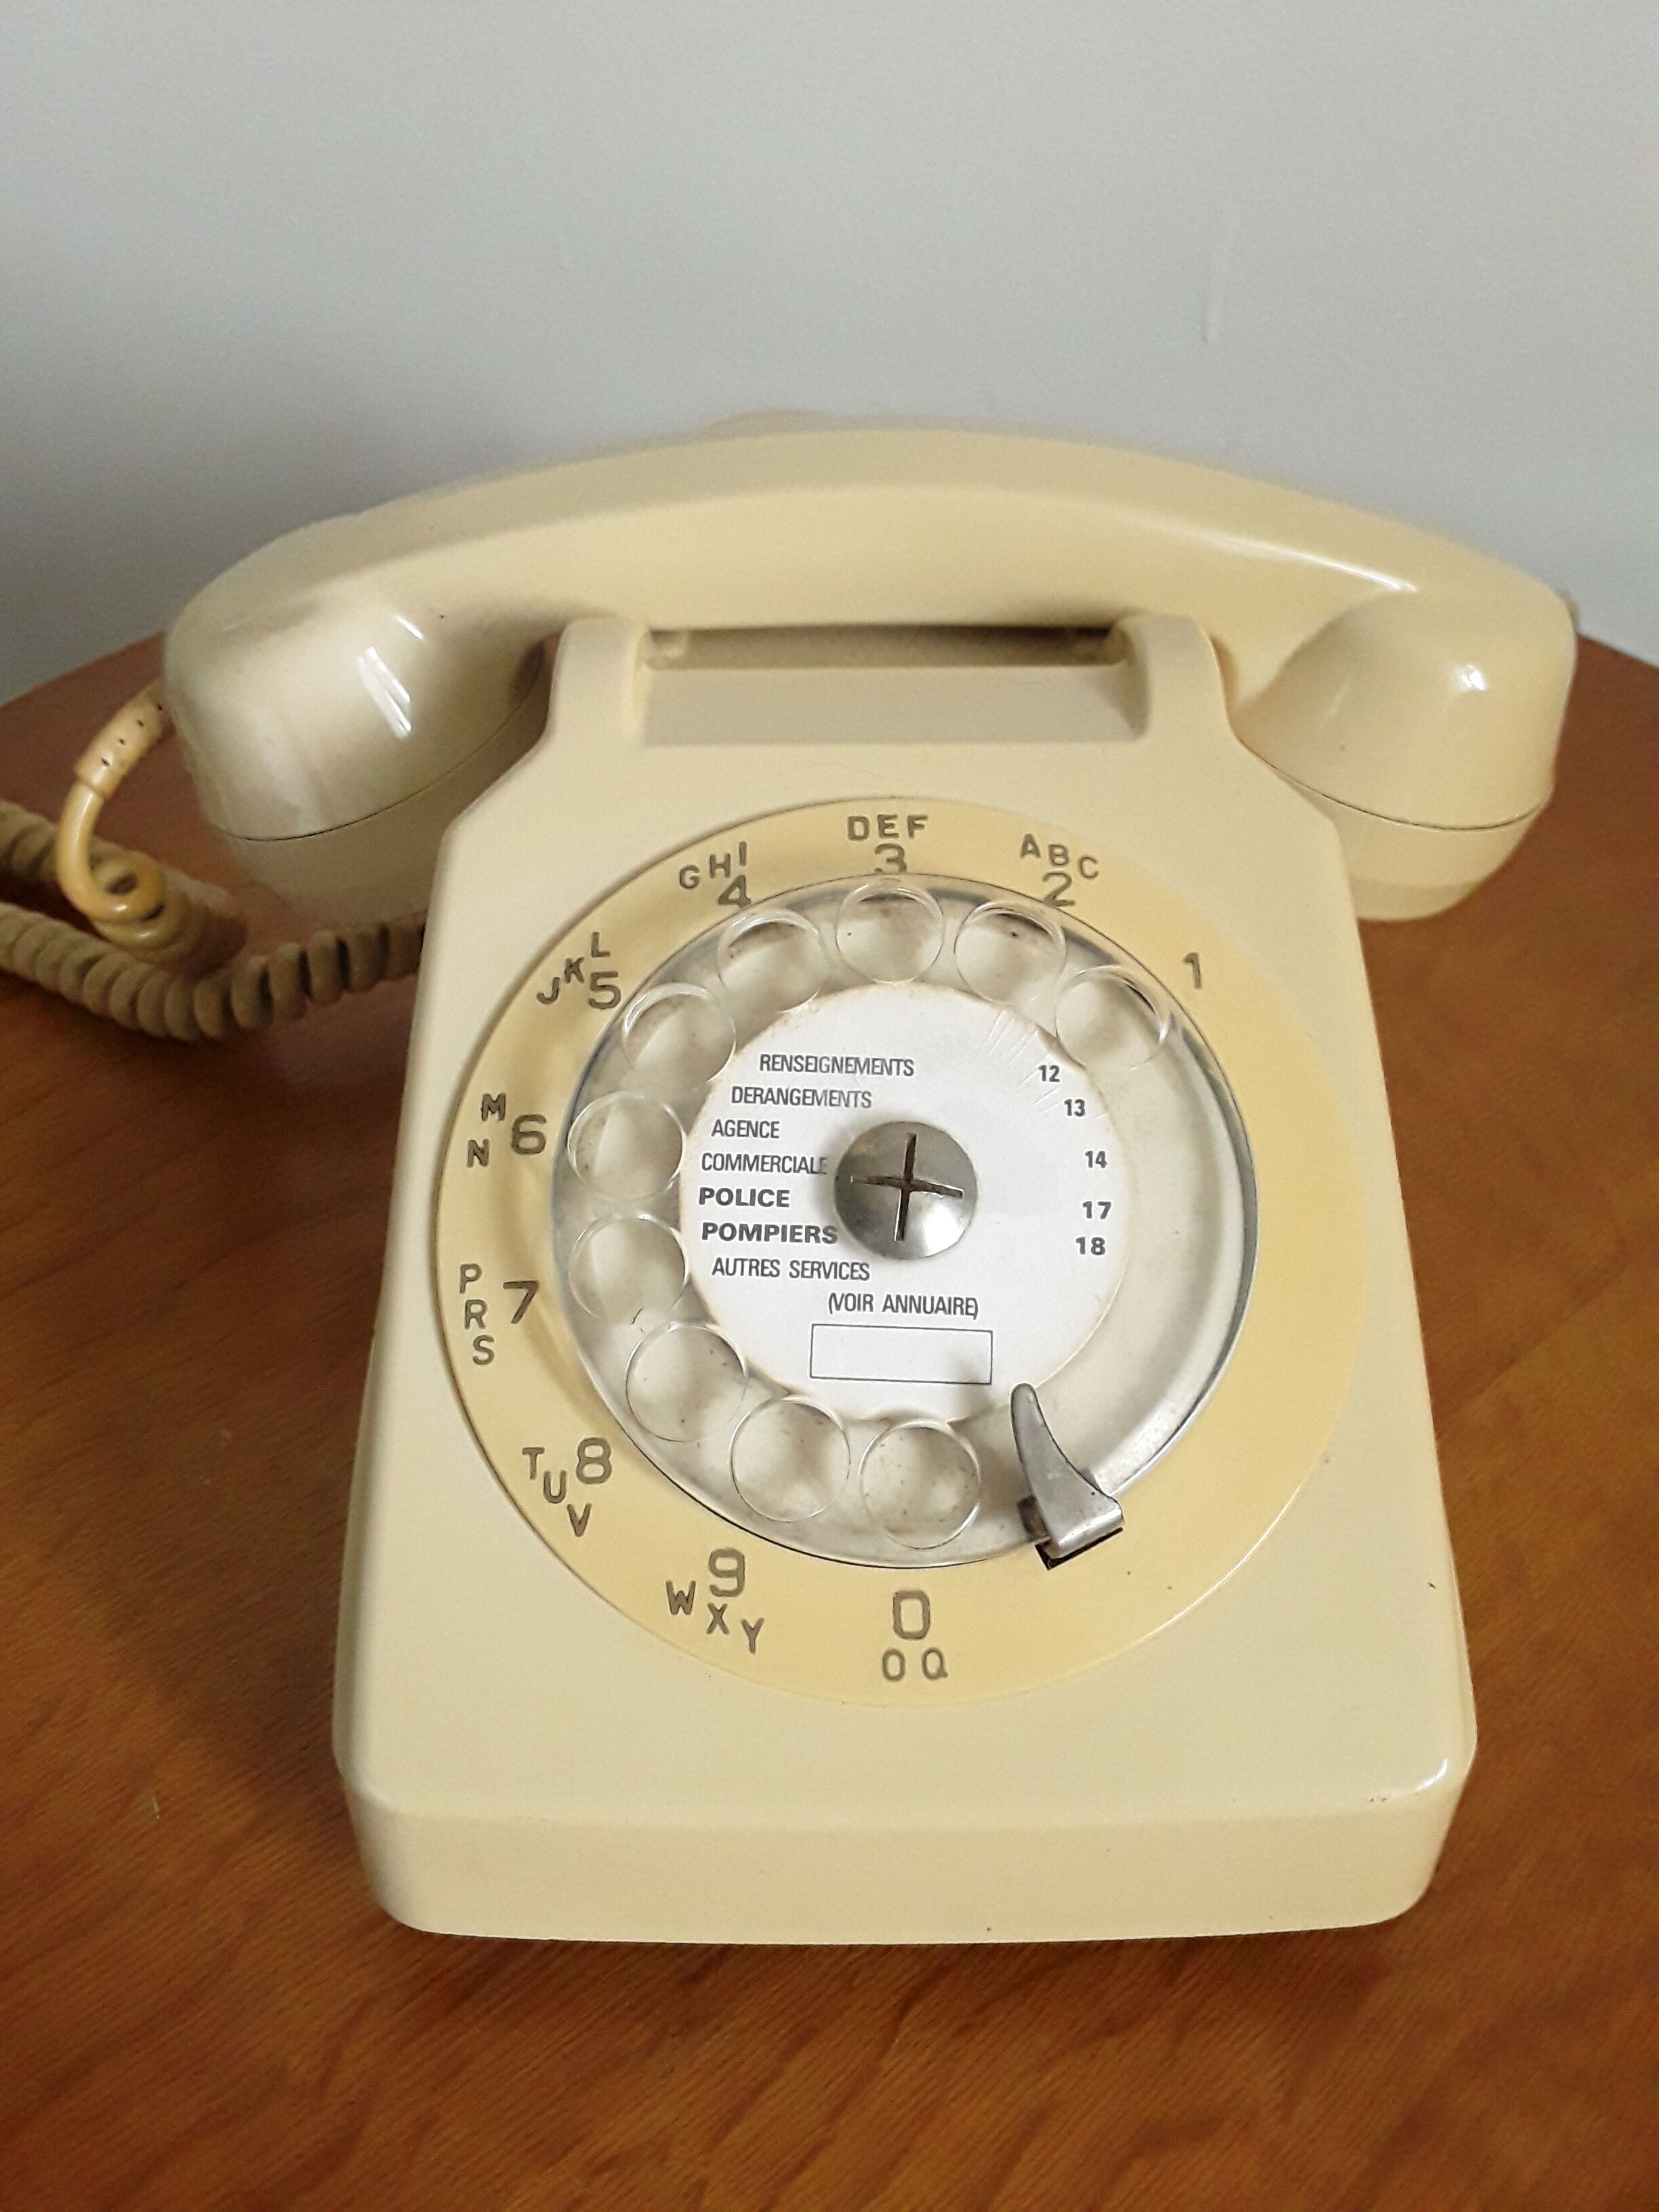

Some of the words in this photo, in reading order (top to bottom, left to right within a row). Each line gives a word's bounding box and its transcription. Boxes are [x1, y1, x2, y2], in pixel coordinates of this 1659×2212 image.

[875, 844, 907, 873] 3
[717, 874, 750, 908] 4
[1042, 872, 1075, 906] 2
[1184, 952, 1202, 989] 1
[589, 971, 621, 1009] 5
[760, 1054, 915, 1077] RENSEIGNEMENTS
[1038, 1064, 1061, 1082] 12
[731, 1086, 872, 1109] DERANGEMENTS
[1064, 1099, 1086, 1117] 13
[510, 1114, 547, 1155] 6
[711, 1120, 780, 1139] AGENCE
[701, 1153, 827, 1174] COMMERCIALE
[1086, 1151, 1108, 1170] 14
[699, 1188, 790, 1208] POLICE
[1083, 1202, 1111, 1220] 17
[702, 1223, 838, 1244] POMPIERS
[1076, 1237, 1106, 1256] 18
[712, 1258, 781, 1277] AUTRES
[789, 1261, 870, 1281] SERVICES
[503, 1280, 539, 1324] 7
[828, 1294, 874, 1314] (VOIR
[882, 1294, 979, 1320] ANNUAIRE)
[576, 1437, 612, 1485] 8
[708, 1548, 745, 1597] 9
